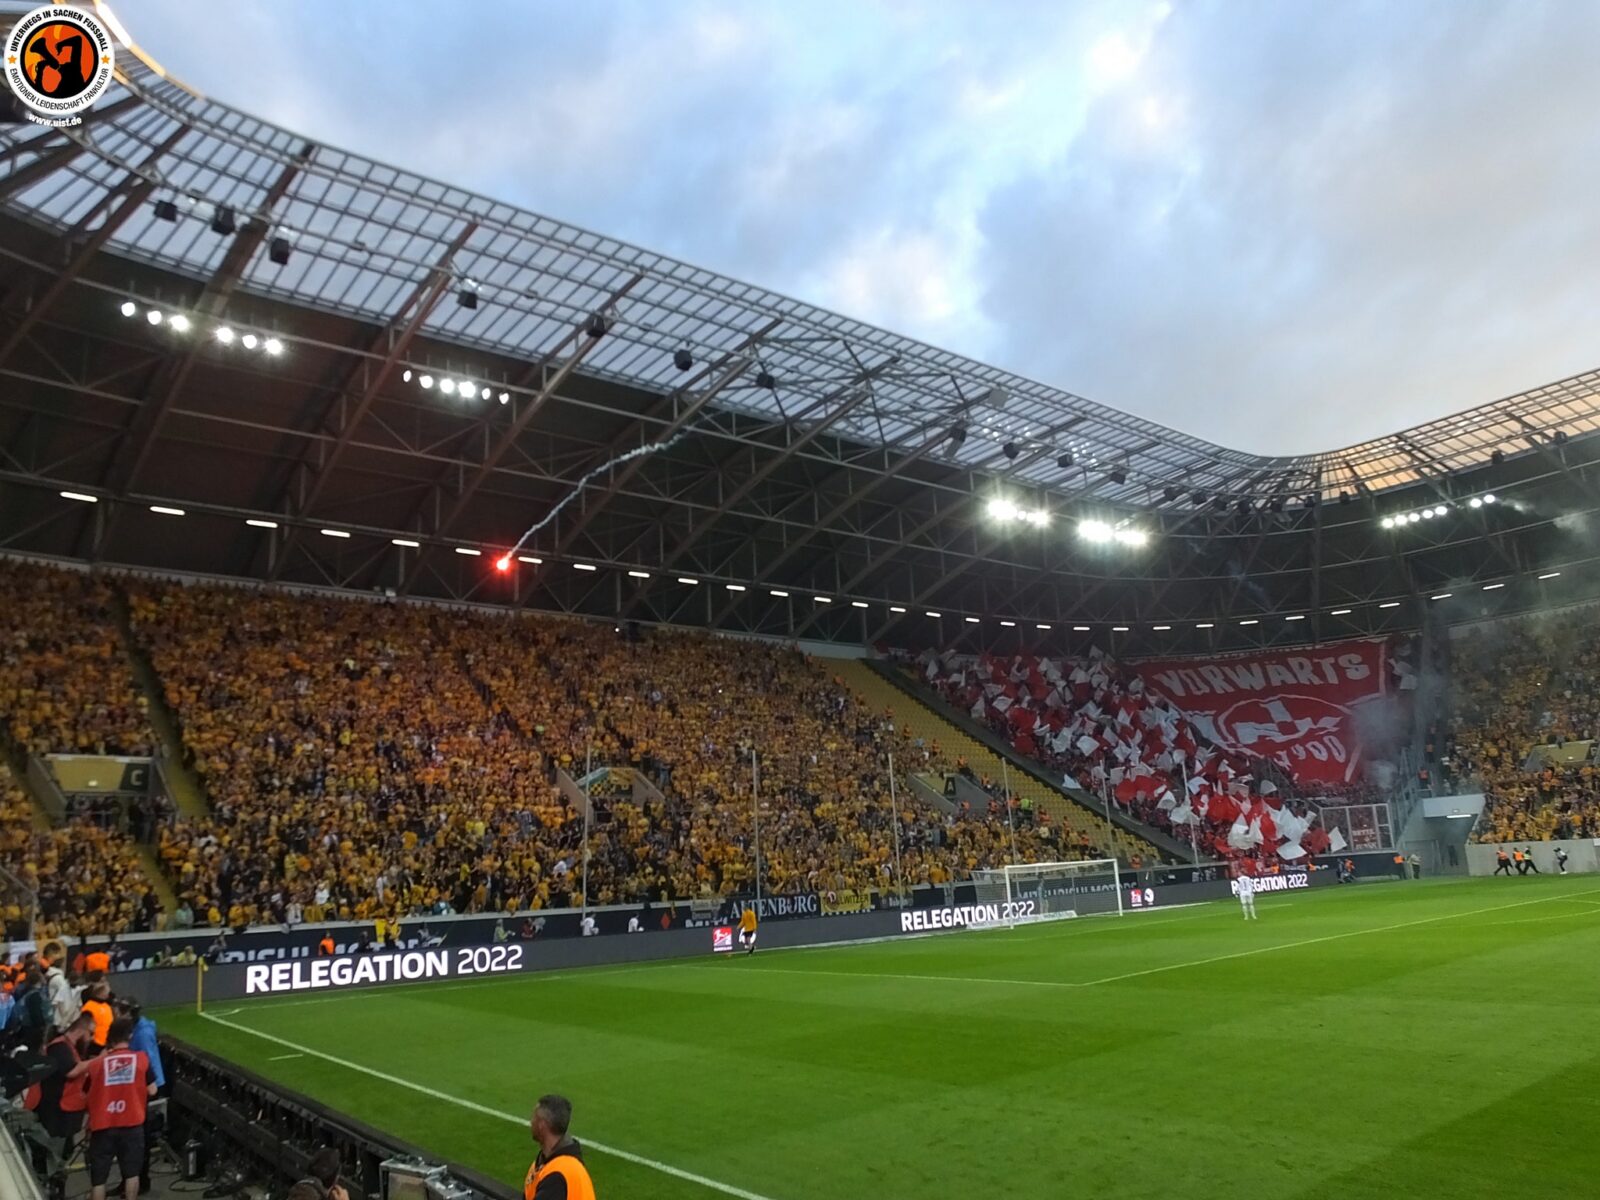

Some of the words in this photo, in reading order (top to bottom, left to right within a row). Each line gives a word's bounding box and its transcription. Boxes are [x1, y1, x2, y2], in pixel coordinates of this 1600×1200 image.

[1152, 653, 1371, 697] VORWÄRTS
[130, 769, 143, 786] C
[1288, 873, 1309, 889] 2022
[901, 902, 998, 932] RELEGATION
[1002, 900, 1035, 919] 2022
[245, 950, 449, 994] RELEGATION
[457, 944, 523, 975] 2022
[106, 1099, 126, 1113] 40
